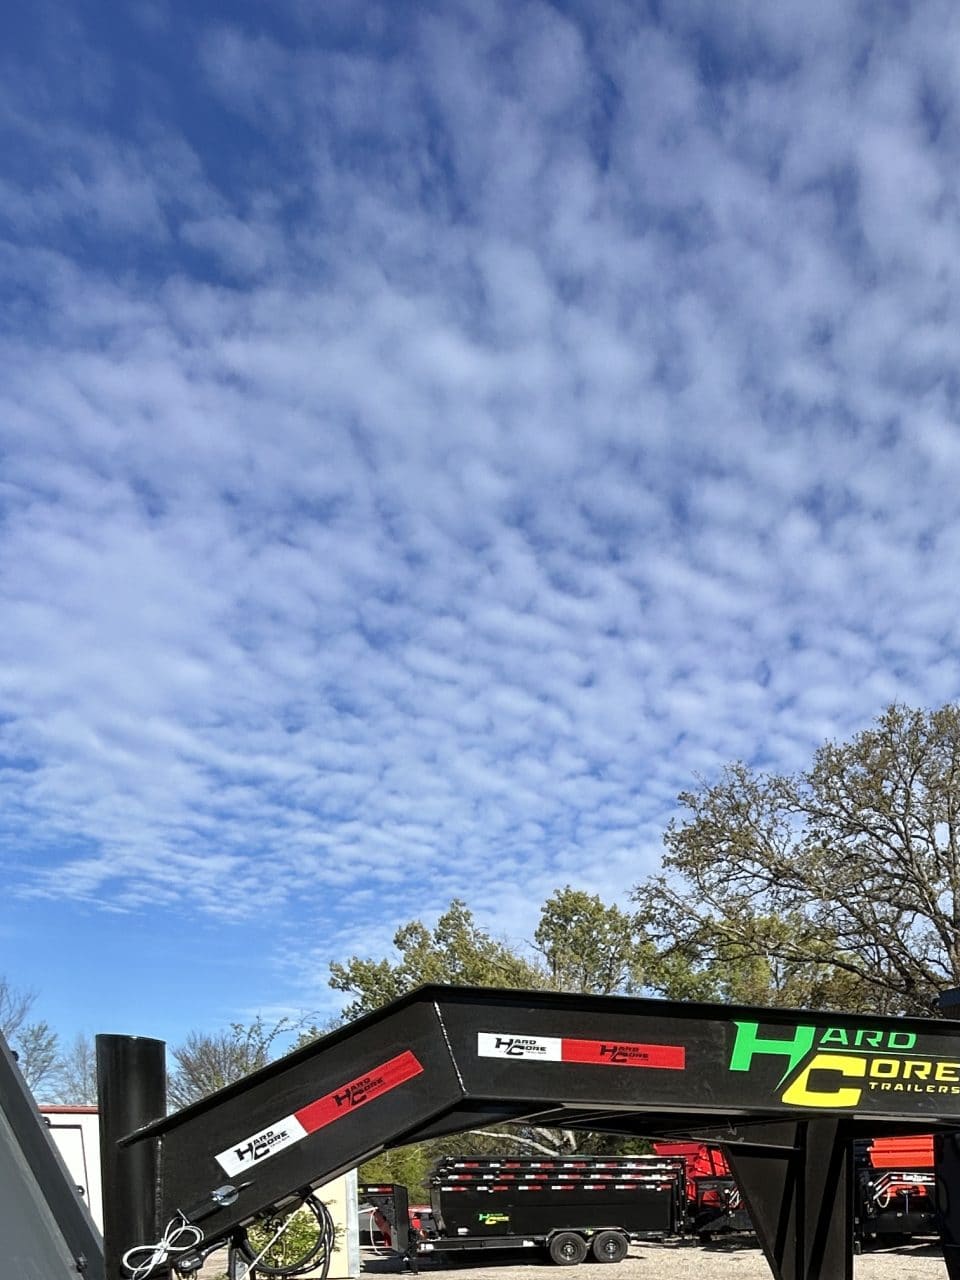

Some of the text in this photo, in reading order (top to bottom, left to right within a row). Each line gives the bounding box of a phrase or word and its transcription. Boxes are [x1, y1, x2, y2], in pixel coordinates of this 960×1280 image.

[495, 1037, 537, 1053] HARD
[506, 1045, 547, 1056] CORE
[729, 1021, 918, 1093] HARD
[332, 1077, 370, 1107] HARD
[868, 1082, 960, 1094] TRAILERS
[233, 1131, 274, 1161] HARD
[254, 1130, 288, 1160] CORE
